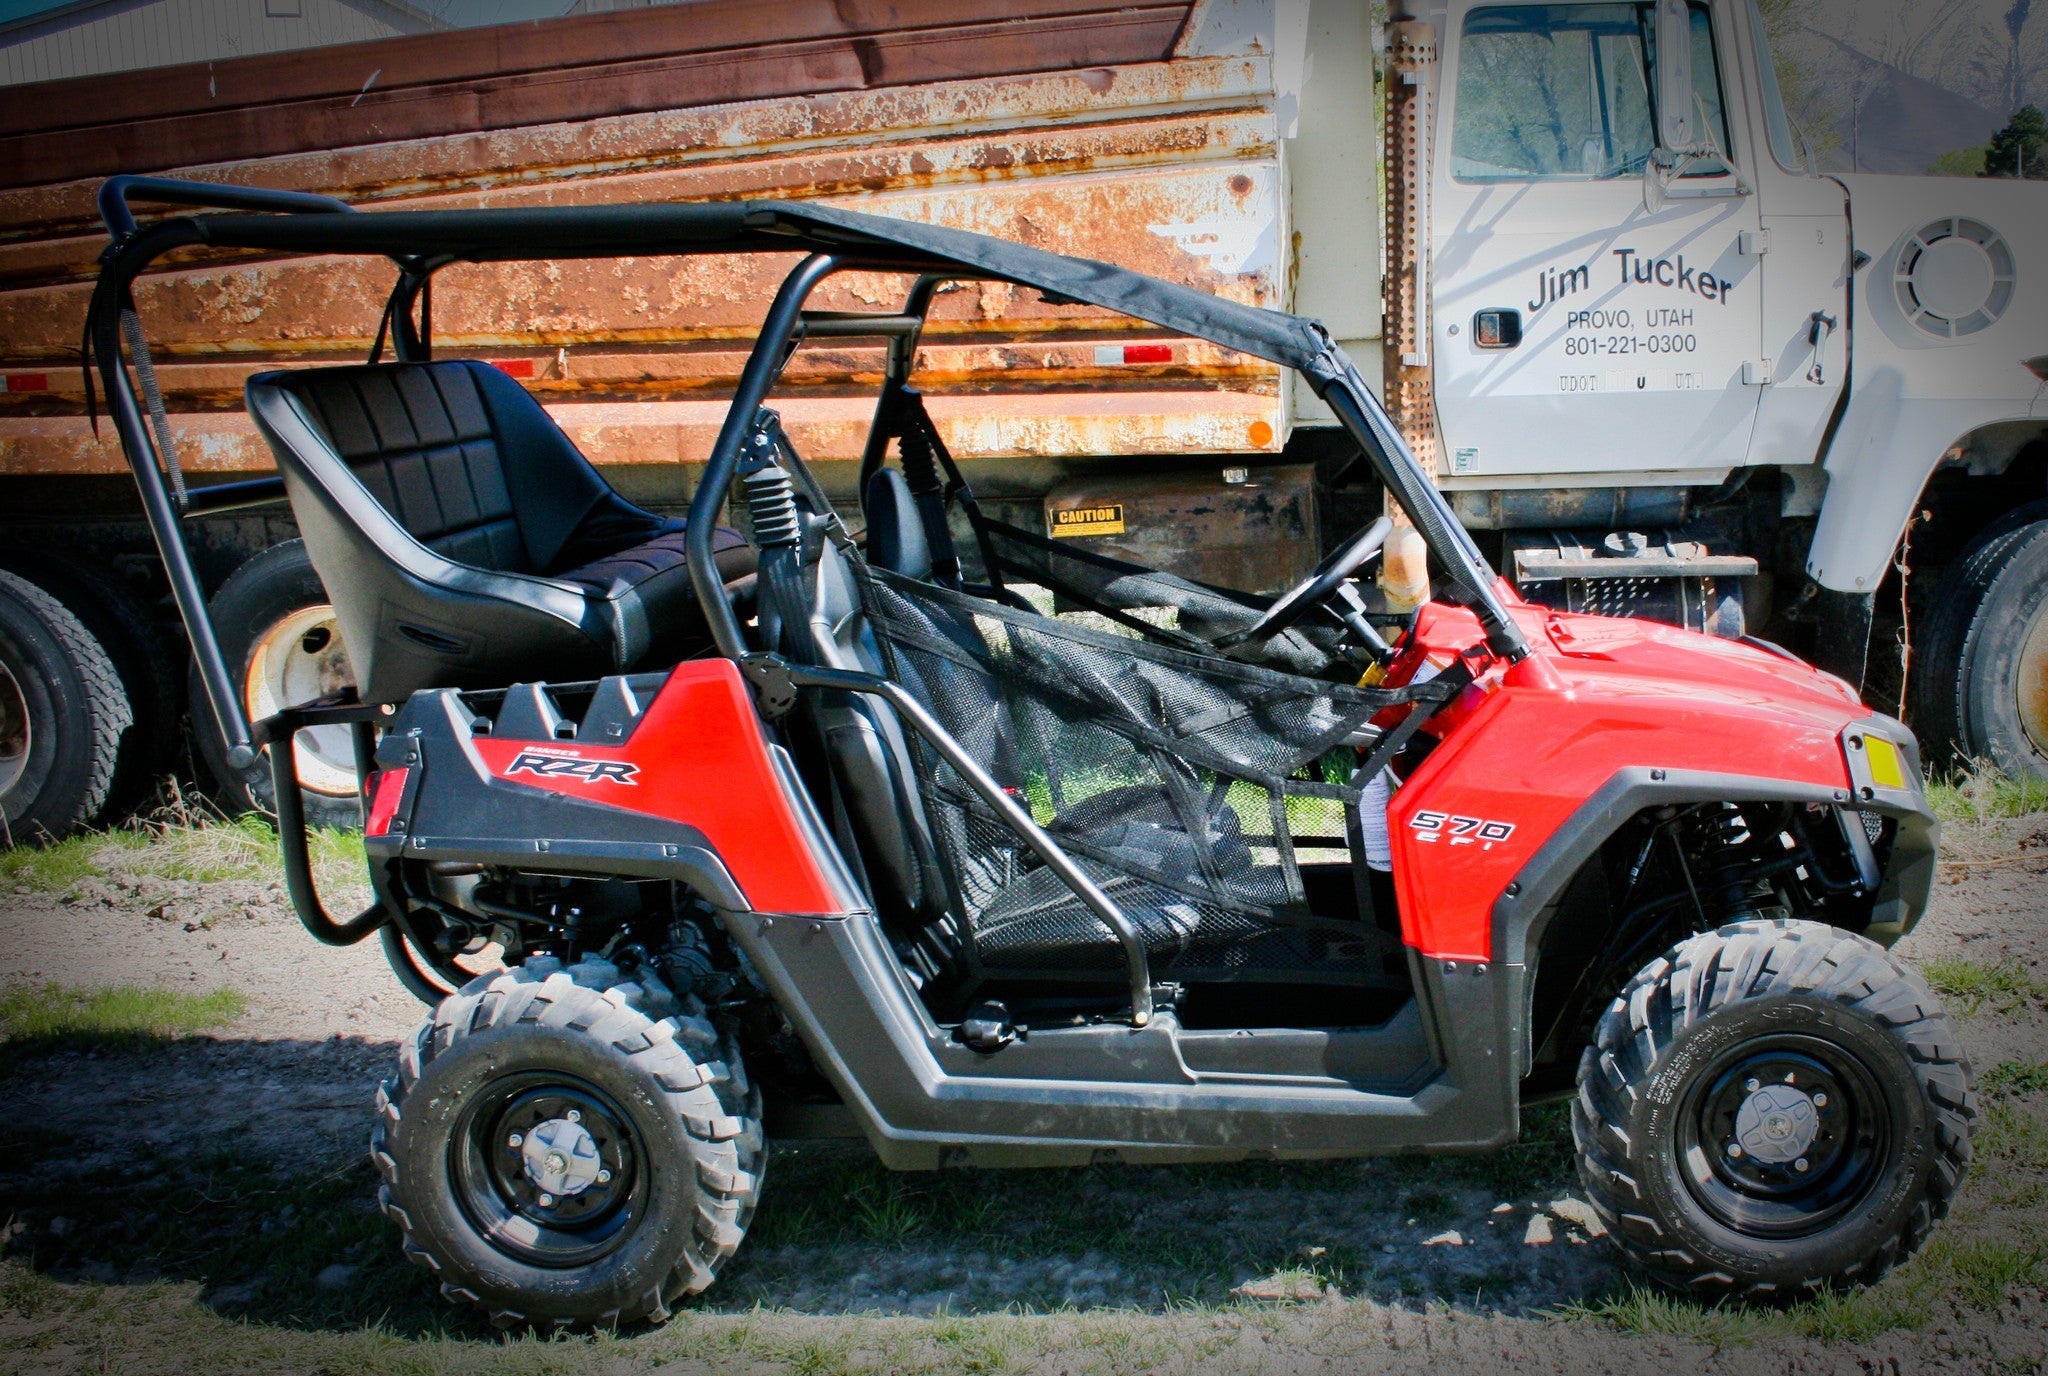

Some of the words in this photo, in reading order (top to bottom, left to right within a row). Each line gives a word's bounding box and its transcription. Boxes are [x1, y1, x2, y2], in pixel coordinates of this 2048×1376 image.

[1528, 264, 1589, 312] Jim
[1613, 248, 1733, 306] Tucker
[1567, 310, 1635, 332] PROVO,
[1646, 308, 1694, 328] UTAH
[1565, 334, 1697, 356] 801-221-0300
[1560, 375, 1596, 392] UDOT
[1637, 376, 1646, 389] U
[1059, 508, 1115, 523] CAUTION
[524, 746, 581, 757] RANGER
[503, 752, 641, 785] RZR
[1409, 810, 1516, 841] 570
